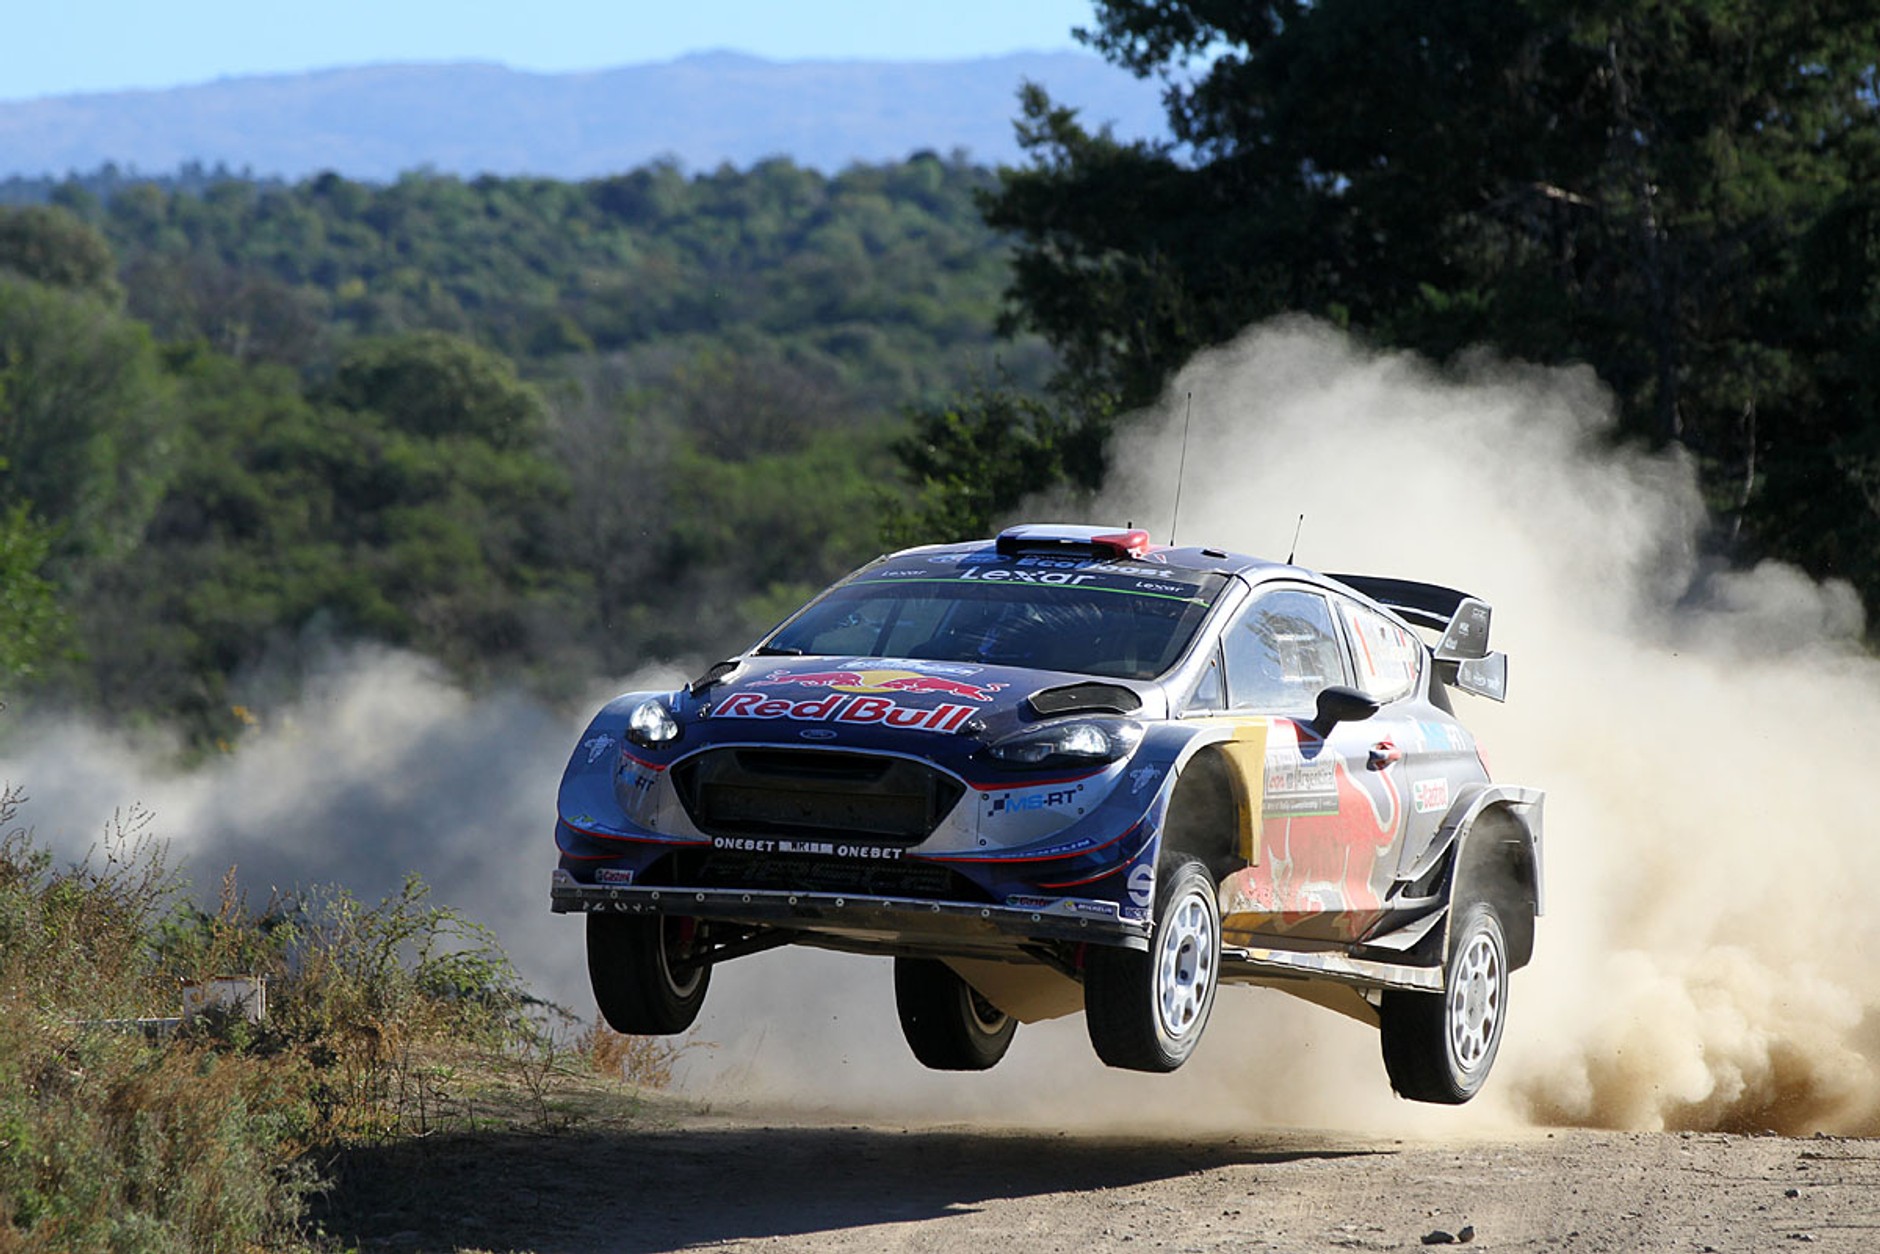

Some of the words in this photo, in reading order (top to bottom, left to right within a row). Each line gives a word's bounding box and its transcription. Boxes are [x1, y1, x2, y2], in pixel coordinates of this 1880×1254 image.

[959, 565, 1097, 585] Lexar
[1135, 581, 1185, 593] Lexar
[711, 693, 848, 720] Red
[835, 696, 979, 734] Bull
[1005, 789, 1077, 814] MS-RT
[714, 836, 775, 852] ONEBET
[837, 845, 902, 860] ONEBET
